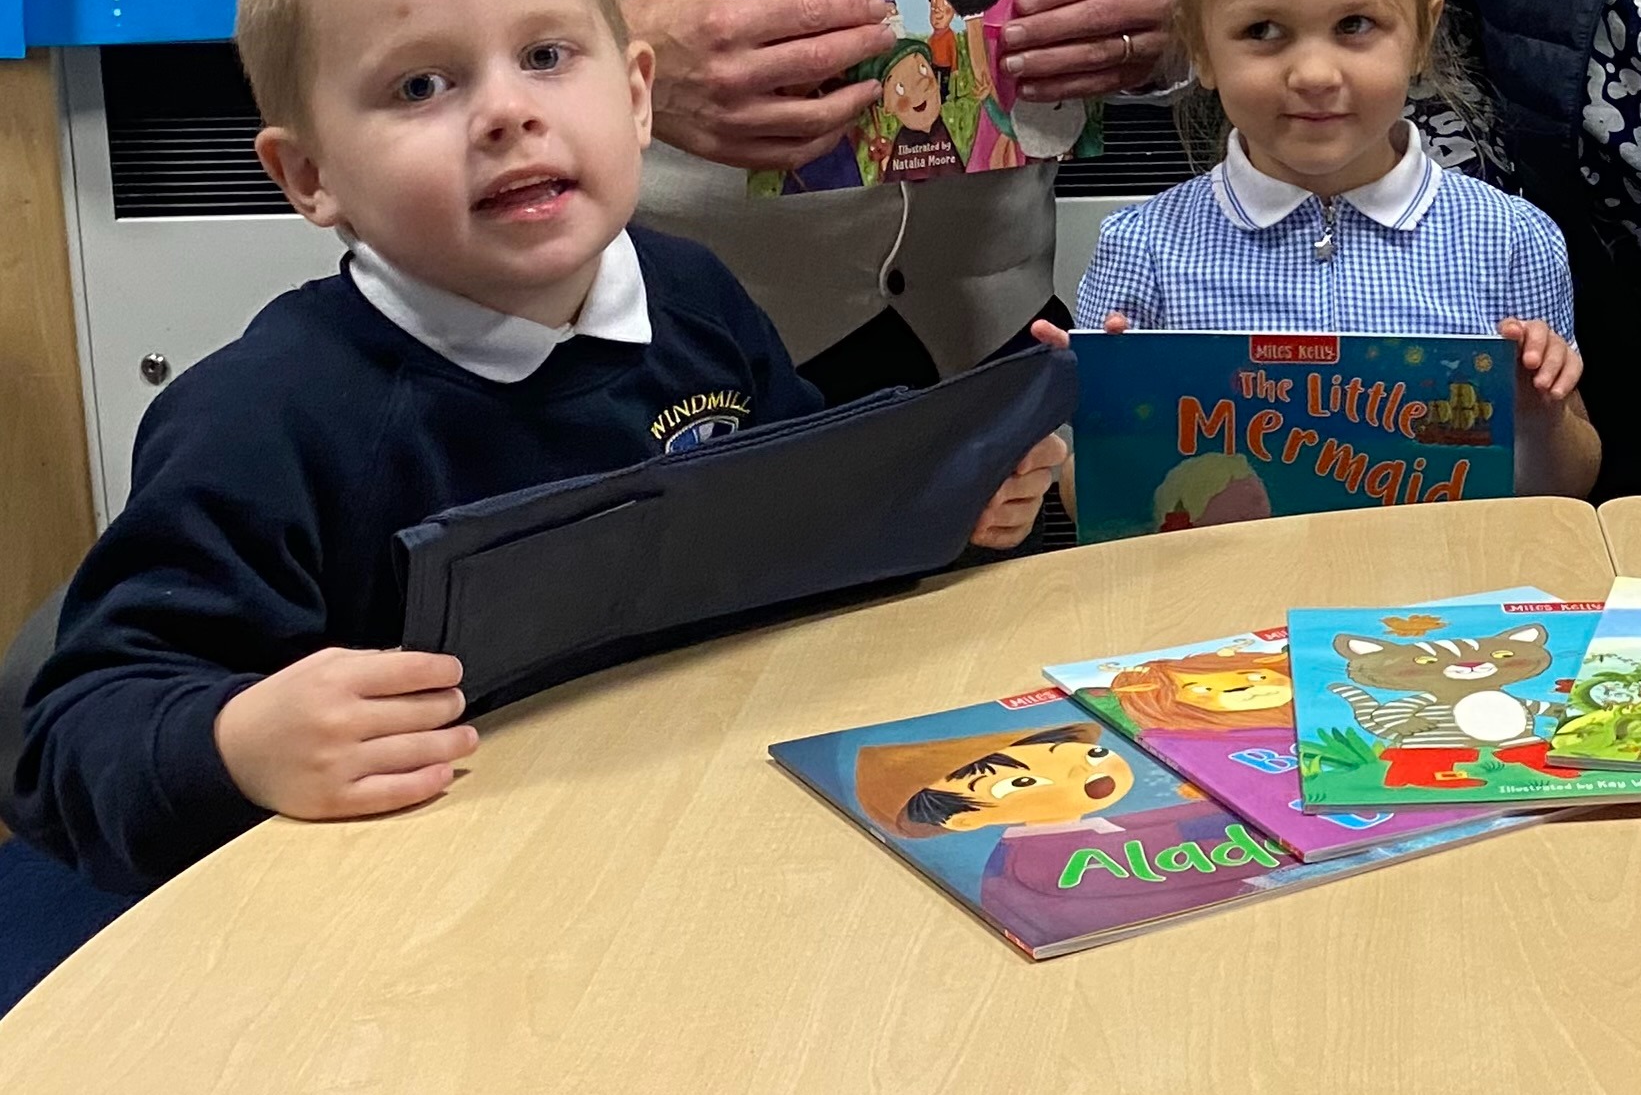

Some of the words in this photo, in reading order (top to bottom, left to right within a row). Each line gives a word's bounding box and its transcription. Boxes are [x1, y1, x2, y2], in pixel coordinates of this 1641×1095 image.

[892, 156, 926, 171] Natalia
[928, 155, 956, 166] Moore
[898, 142, 940, 156] Illustrated
[941, 141, 952, 152] by
[651, 390, 751, 440] WINDMILL
[1238, 369, 1294, 404] The
[1306, 372, 1428, 440] Little
[1177, 395, 1471, 506] Mermaid
[1498, 782, 1572, 794] Illustrated
[1576, 783, 1593, 791] by
[1597, 780, 1627, 788] Kay
[1058, 823, 1284, 888] Alad
